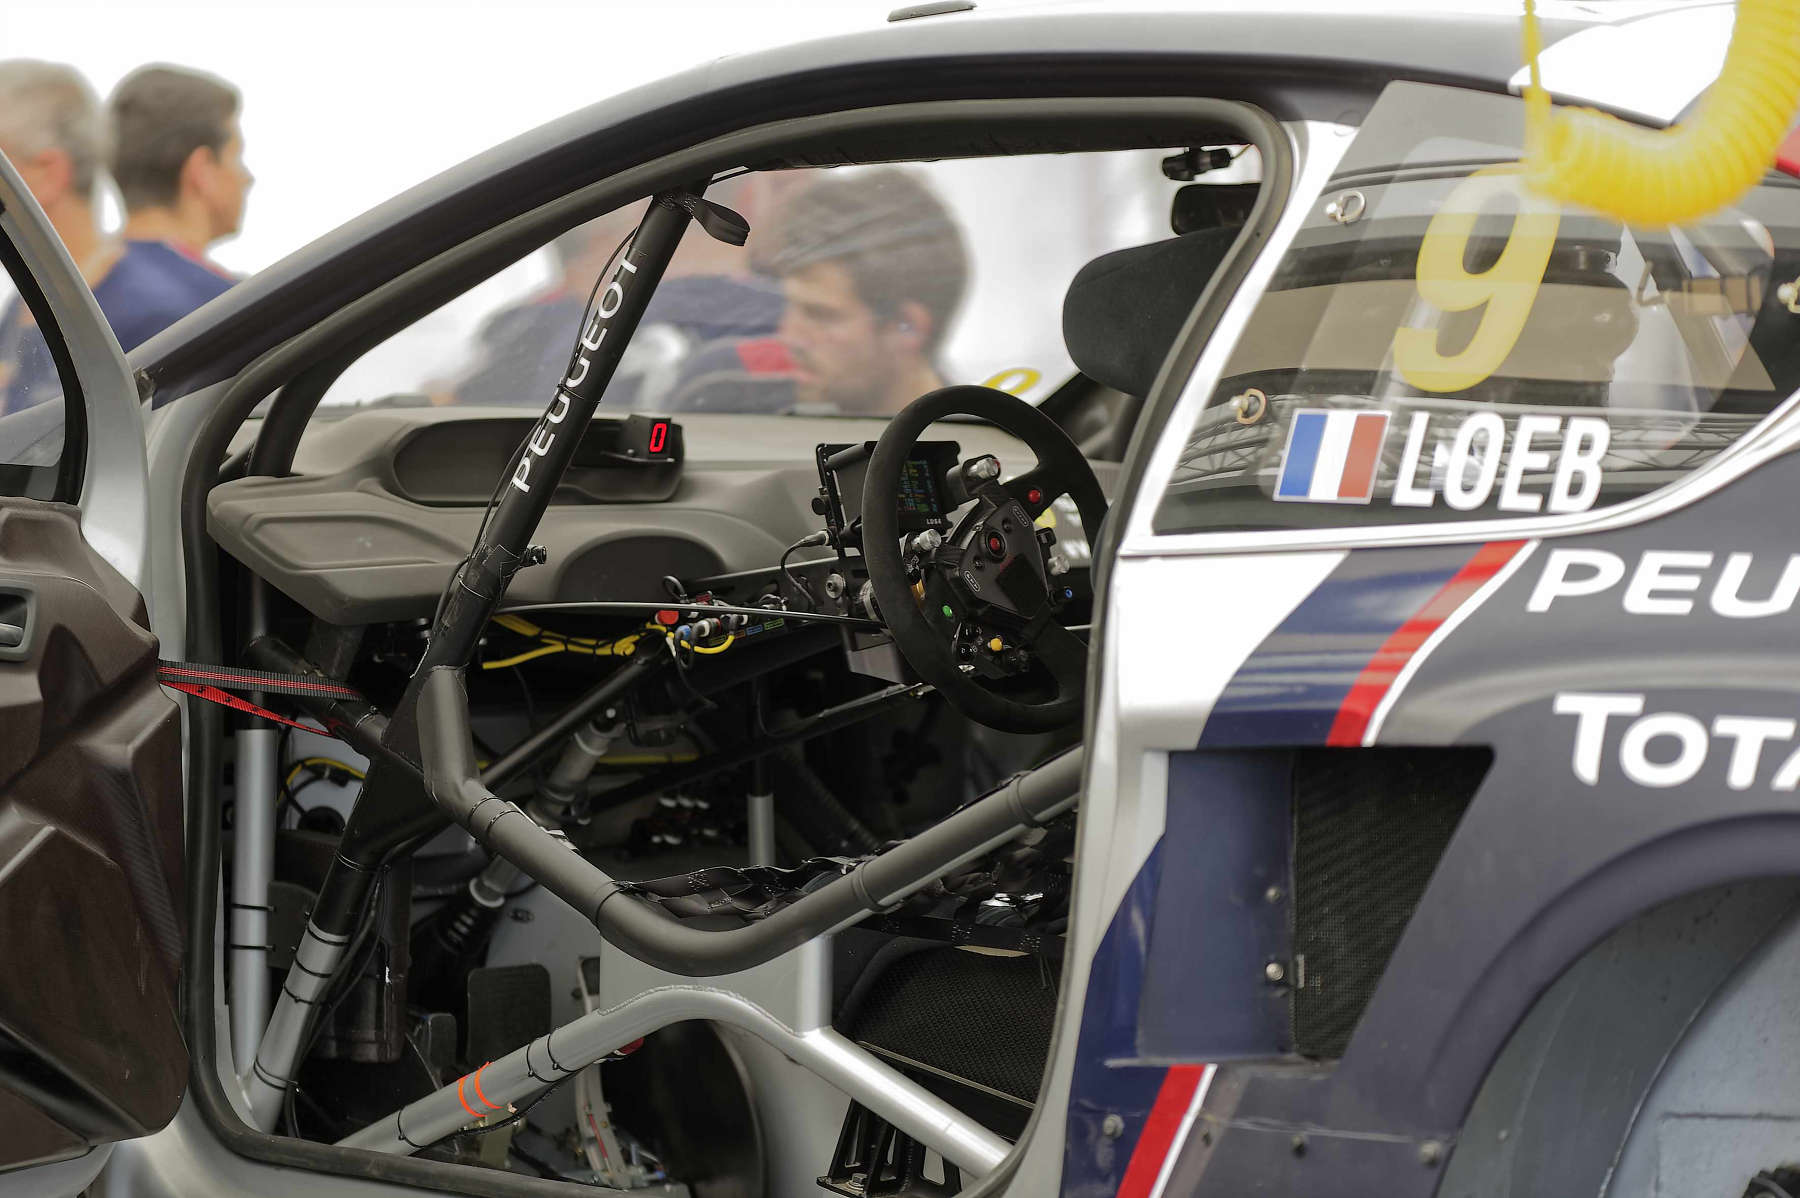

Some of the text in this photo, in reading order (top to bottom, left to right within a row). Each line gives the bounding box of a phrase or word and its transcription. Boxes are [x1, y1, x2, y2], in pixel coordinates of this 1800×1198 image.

[1394, 161, 1562, 392] 9
[512, 256, 638, 493] PEUGEOT
[649, 422, 667, 453] 0
[1391, 410, 1611, 513] LOEB
[1526, 548, 1800, 618] PEU
